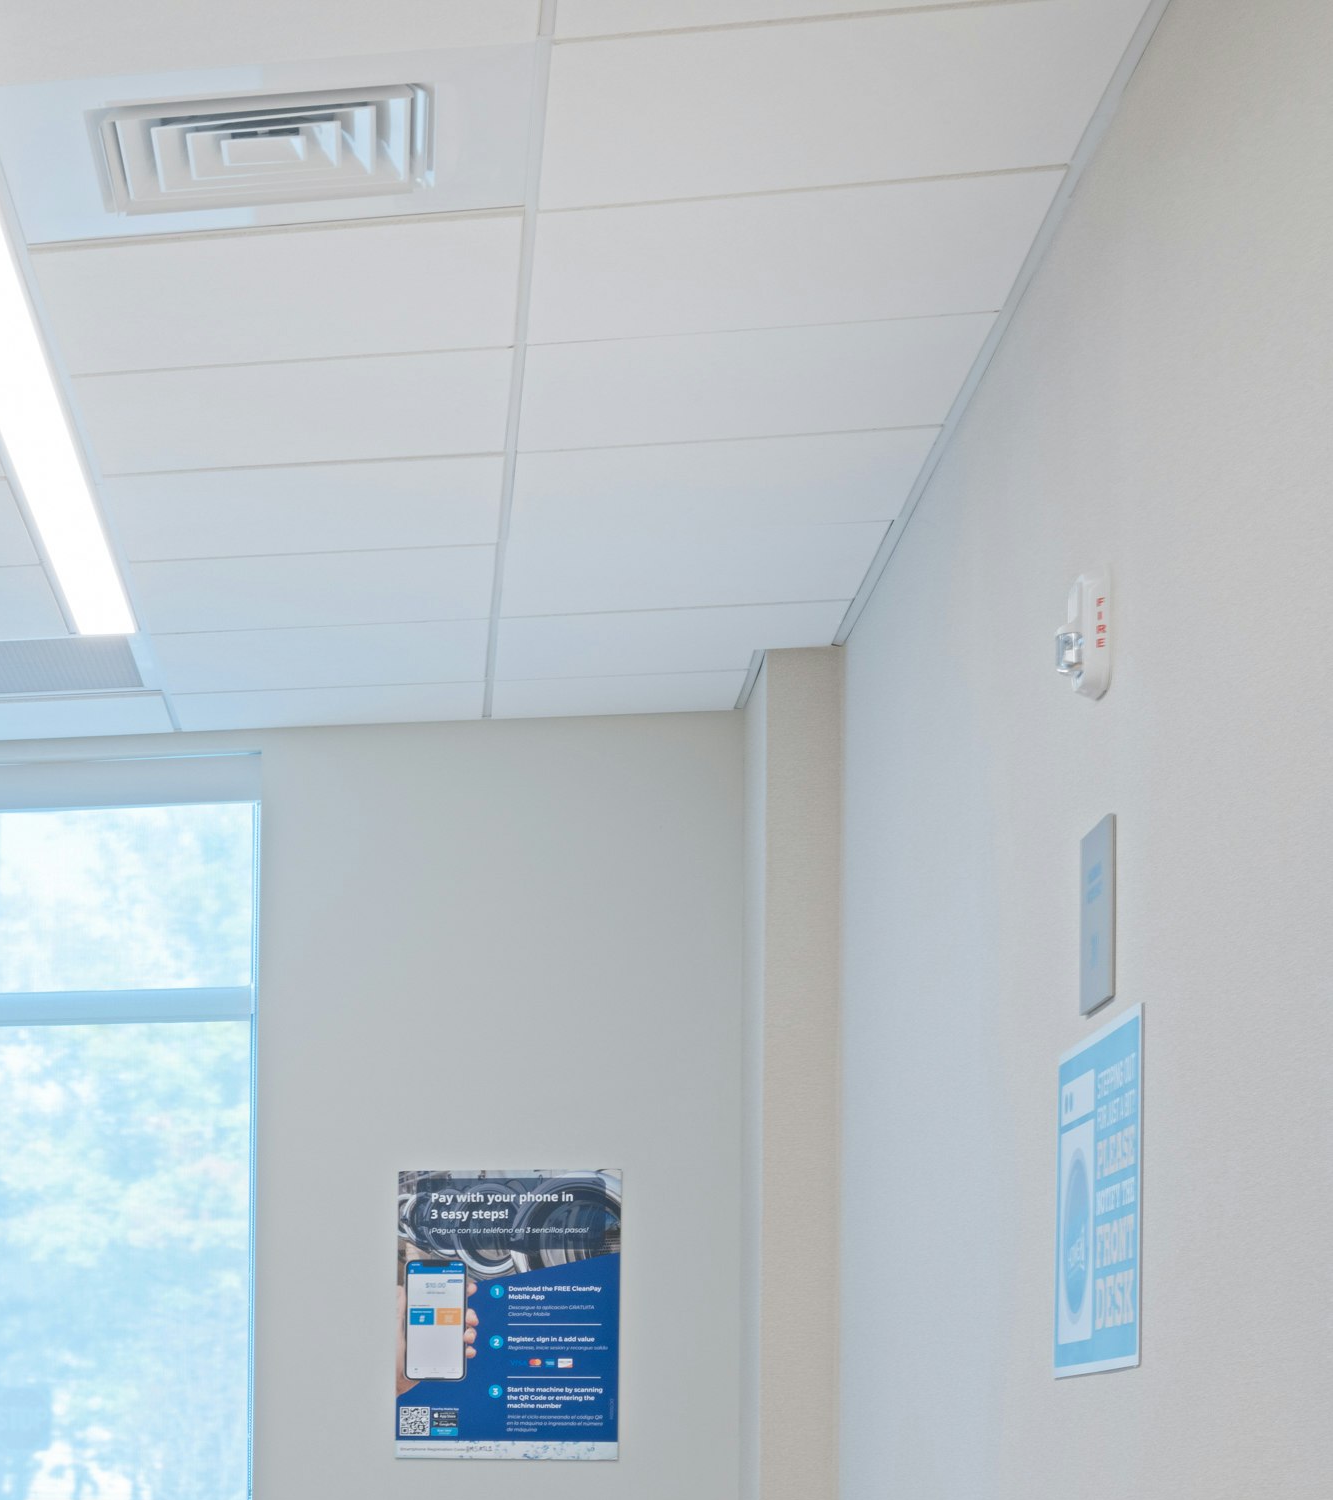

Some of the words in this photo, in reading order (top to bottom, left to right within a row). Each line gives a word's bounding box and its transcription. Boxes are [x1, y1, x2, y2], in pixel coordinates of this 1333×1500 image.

[1096, 597, 1106, 648] FIRE
[1097, 1060, 1125, 1099] STEPPING
[1125, 1052, 1136, 1084] OUT
[1096, 1123, 1136, 1181] PLEASE
[431, 1193, 454, 1205] Pay
[457, 1191, 484, 1203] with
[487, 1193, 515, 1205] your
[519, 1191, 558, 1204] phone
[562, 1191, 574, 1202] in
[1096, 1183, 1121, 1216] NOTIFY
[1122, 1176, 1136, 1208] THE
[430, 1209, 439, 1220] 3
[441, 1211, 469, 1222] easy
[472, 1209, 509, 1221] steps!
[428, 1227, 456, 1236] ¡Pague
[483, 1226, 513, 1234] teléfono
[532, 1226, 564, 1234] sencillos
[564, 1227, 590, 1235] pasos!
[1095, 1213, 1135, 1269] FRONT
[571, 1285, 602, 1293] CleanPay
[1094, 1269, 1134, 1330] DESK
[493, 1338, 500, 1346] 2
[493, 1388, 499, 1396] 3
